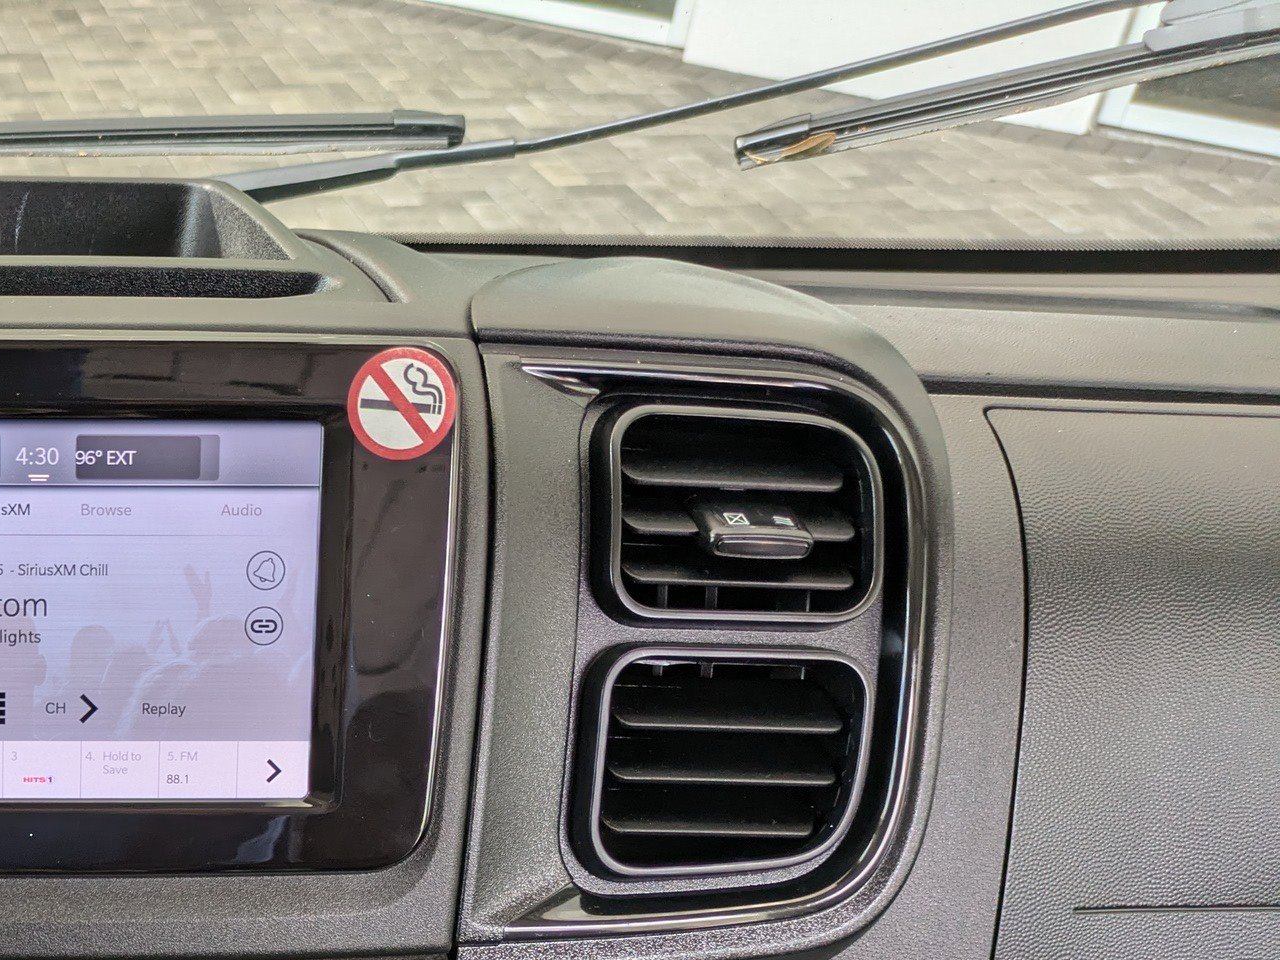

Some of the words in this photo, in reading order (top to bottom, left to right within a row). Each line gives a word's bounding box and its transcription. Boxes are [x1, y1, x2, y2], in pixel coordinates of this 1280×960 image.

[15, 447, 59, 466] 4:30
[74, 449, 104, 466] 96°
[106, 450, 137, 466] EXT
[80, 503, 132, 517] Browse
[220, 503, 263, 517] Audio
[17, 563, 76, 576] SiriusXM
[79, 563, 109, 576] Chill
[45, 702, 66, 715] CH
[141, 702, 187, 718] Replay
[102, 751, 129, 762] Hold
[131, 752, 142, 762] to
[179, 752, 199, 762] FM
[102, 765, 129, 775] Save
[166, 774, 190, 785] 88.1
